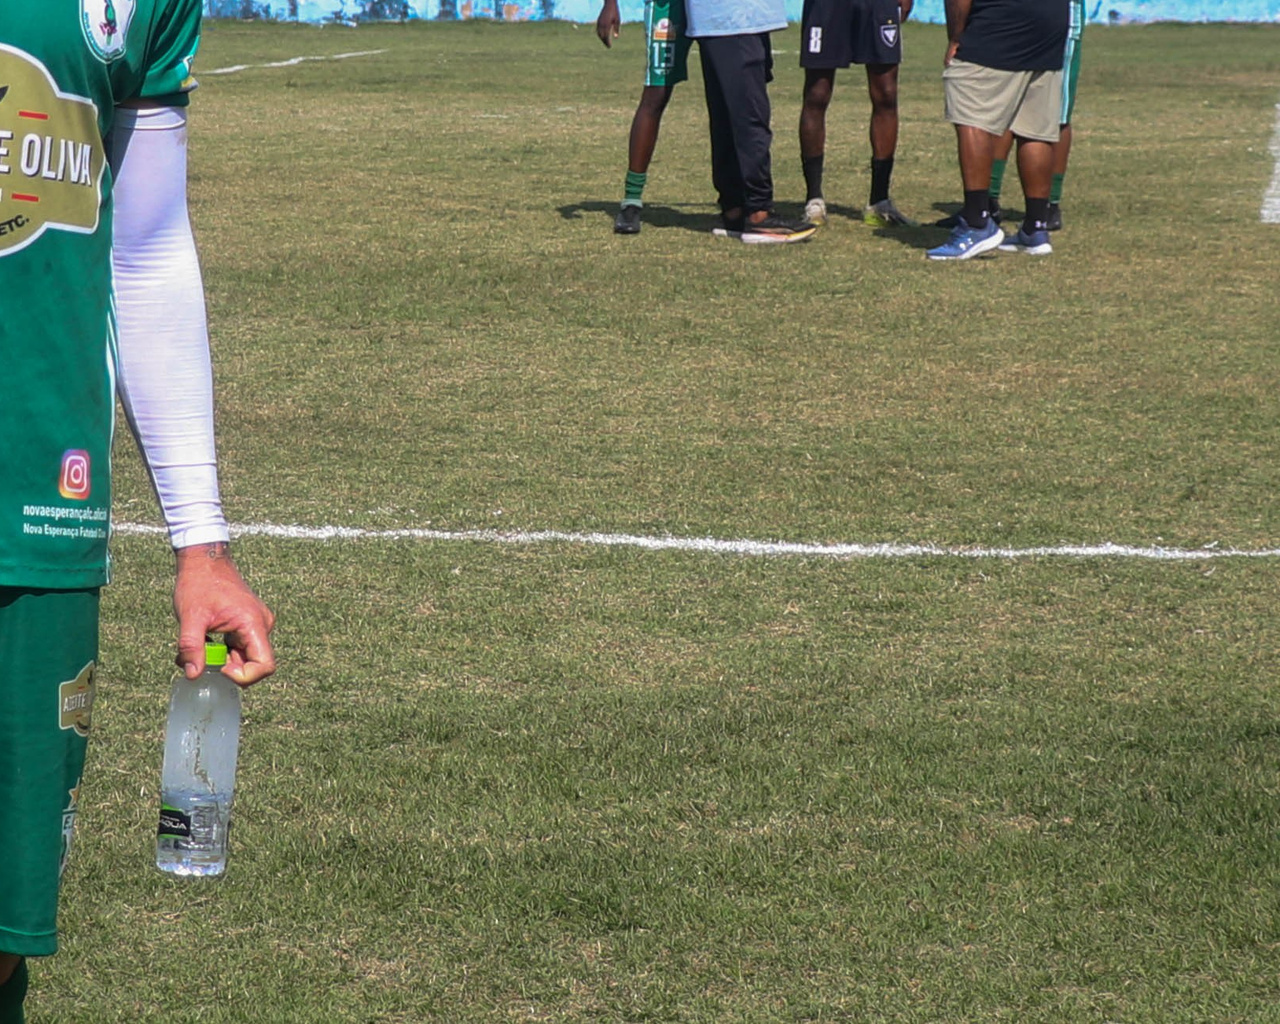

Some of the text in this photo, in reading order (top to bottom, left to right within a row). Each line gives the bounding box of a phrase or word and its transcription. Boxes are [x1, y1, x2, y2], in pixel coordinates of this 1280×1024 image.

[809, 27, 822, 53] 8
[652, 42, 676, 67] 13
[20, 133, 93, 186] OLIVA
[23, 523, 43, 535] Nova
[44, 524, 79, 538] Esperança
